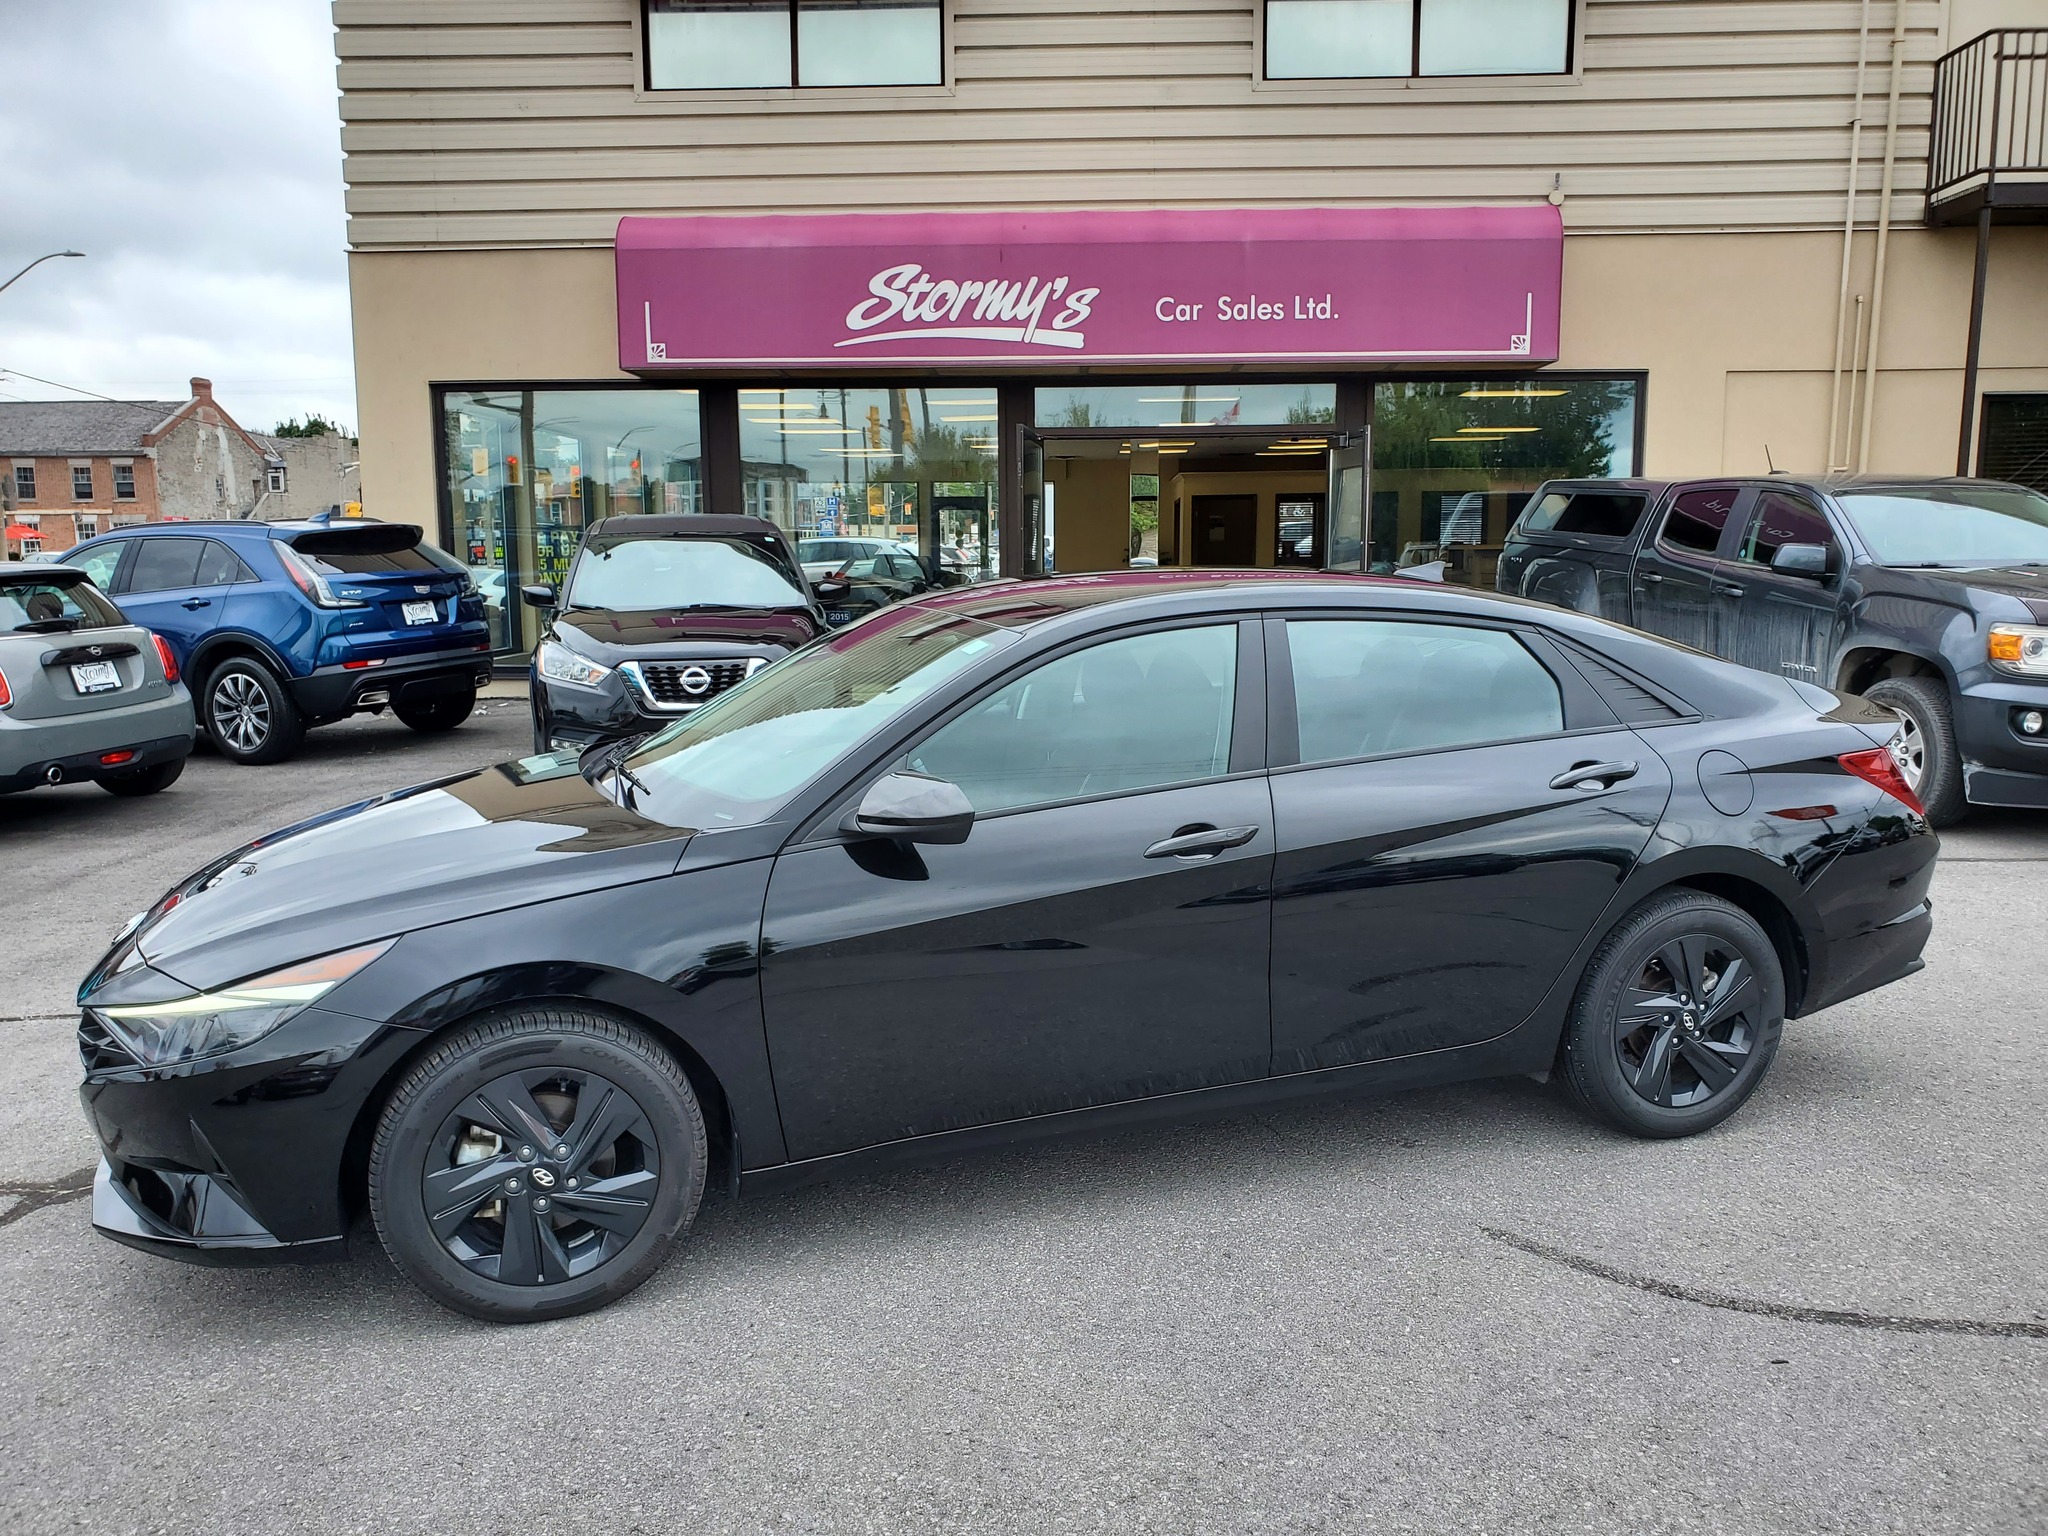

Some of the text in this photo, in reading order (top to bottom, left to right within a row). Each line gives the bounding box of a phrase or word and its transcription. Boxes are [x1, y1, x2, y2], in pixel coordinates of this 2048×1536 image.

[846, 264, 1100, 342] Stormy's
[1155, 294, 1339, 321] Car Sales Ltd.
[829, 613, 849, 621] 2015
[1781, 661, 1817, 673] CANYON
